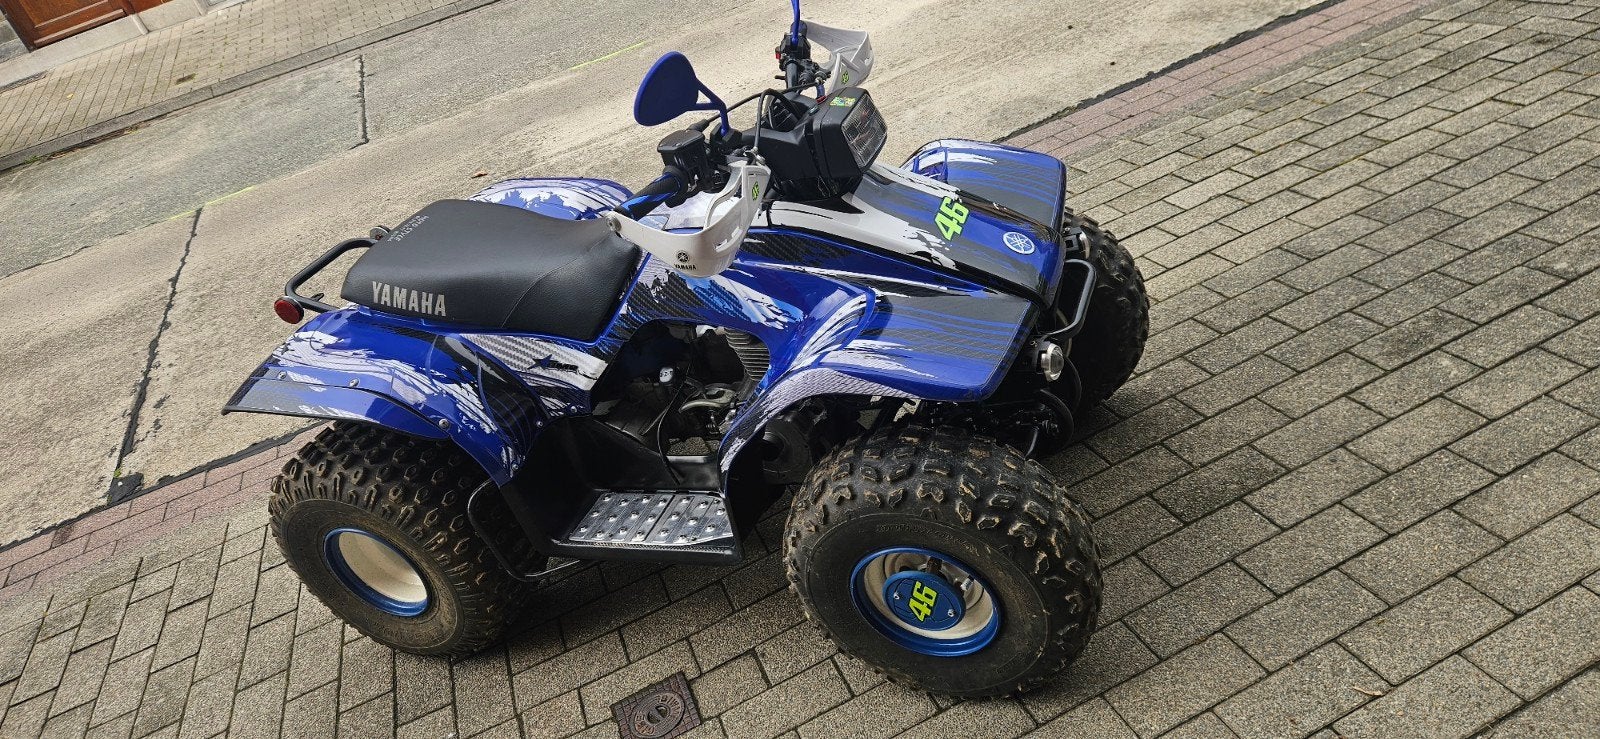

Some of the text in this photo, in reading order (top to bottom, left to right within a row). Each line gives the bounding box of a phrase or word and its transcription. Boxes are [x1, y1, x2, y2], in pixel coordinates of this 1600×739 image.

[934, 196, 969, 241] 46
[372, 281, 446, 317] YAMAHA
[909, 581, 937, 622] 46
